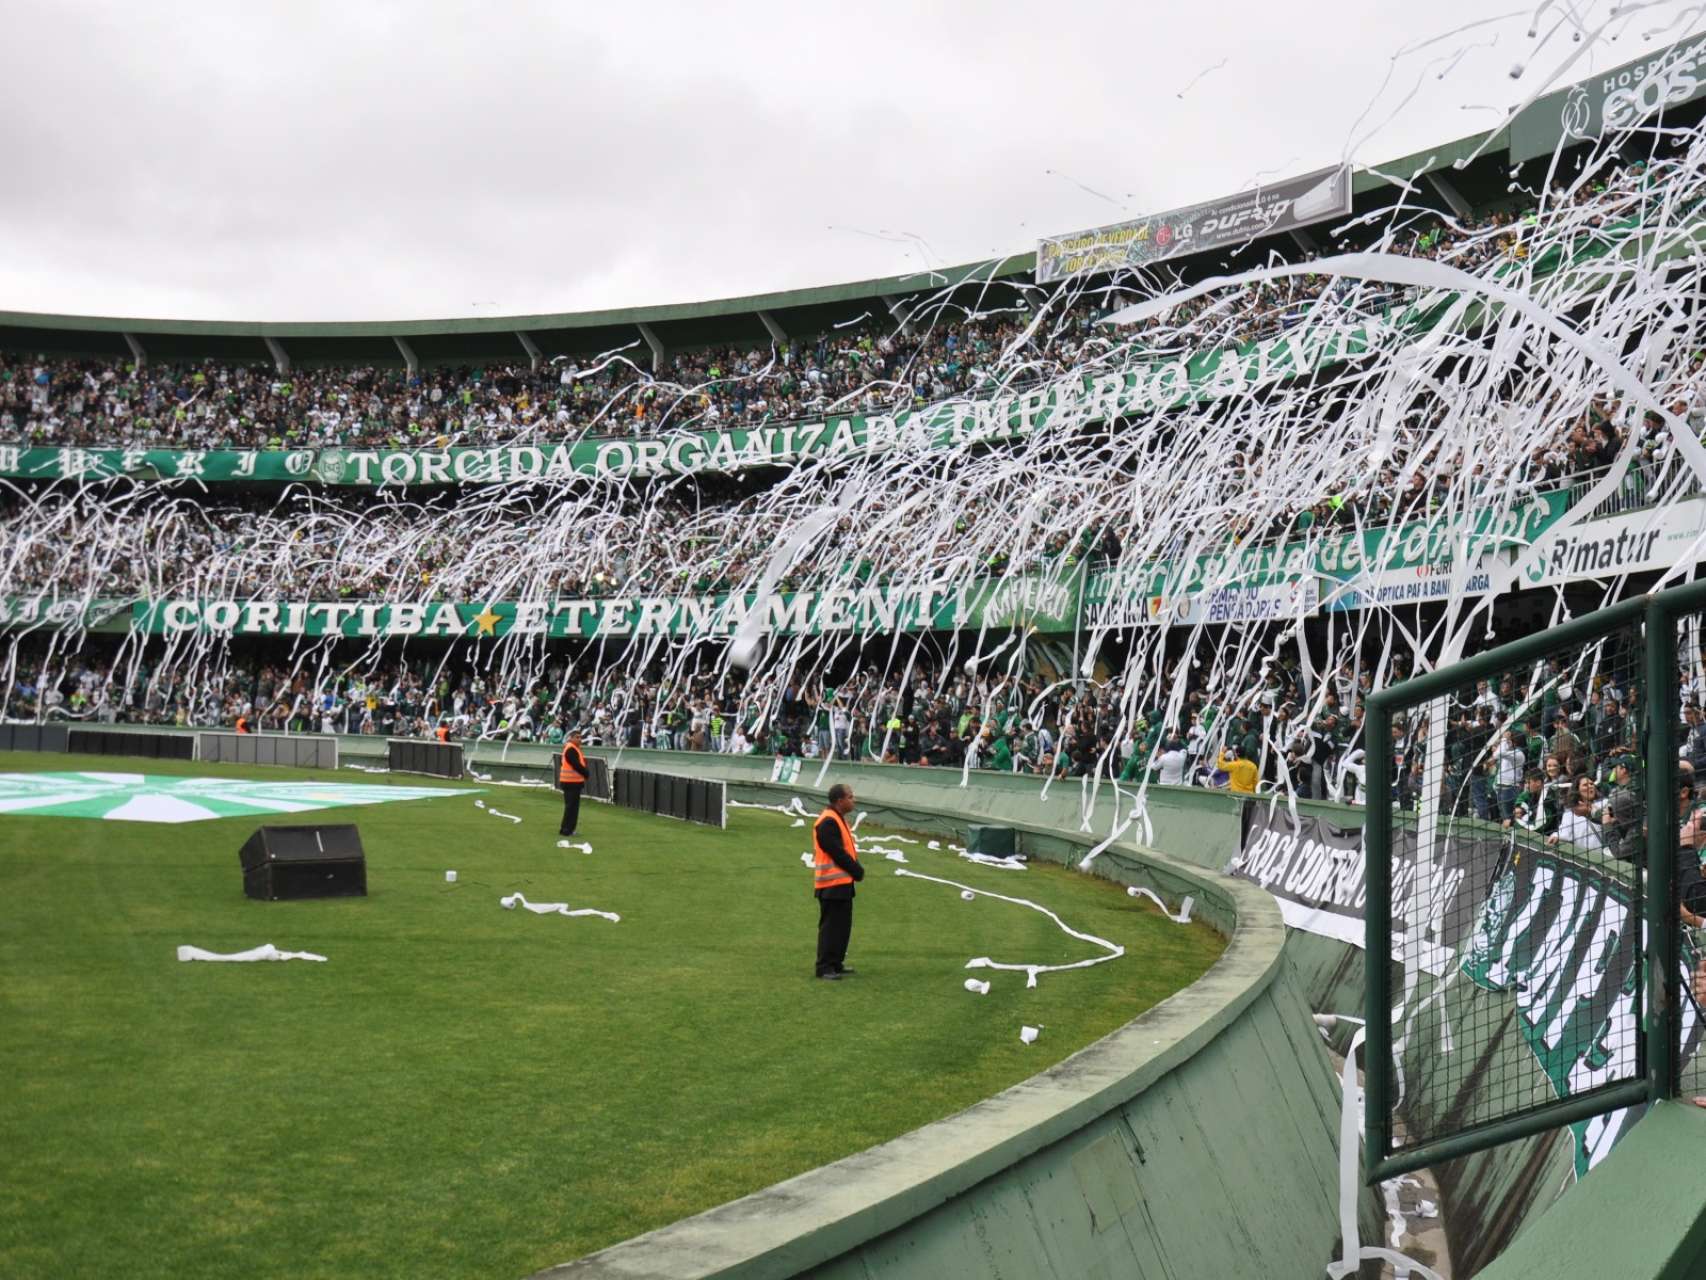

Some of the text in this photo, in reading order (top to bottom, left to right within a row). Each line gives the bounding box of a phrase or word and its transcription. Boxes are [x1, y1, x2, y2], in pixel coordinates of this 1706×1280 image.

[1174, 224, 1192, 240] LG
[346, 445, 576, 485] TORCIDA
[1549, 526, 1661, 577] Rimatur
[1460, 573, 1490, 593] ARGA
[163, 601, 467, 635] CORITIBA
